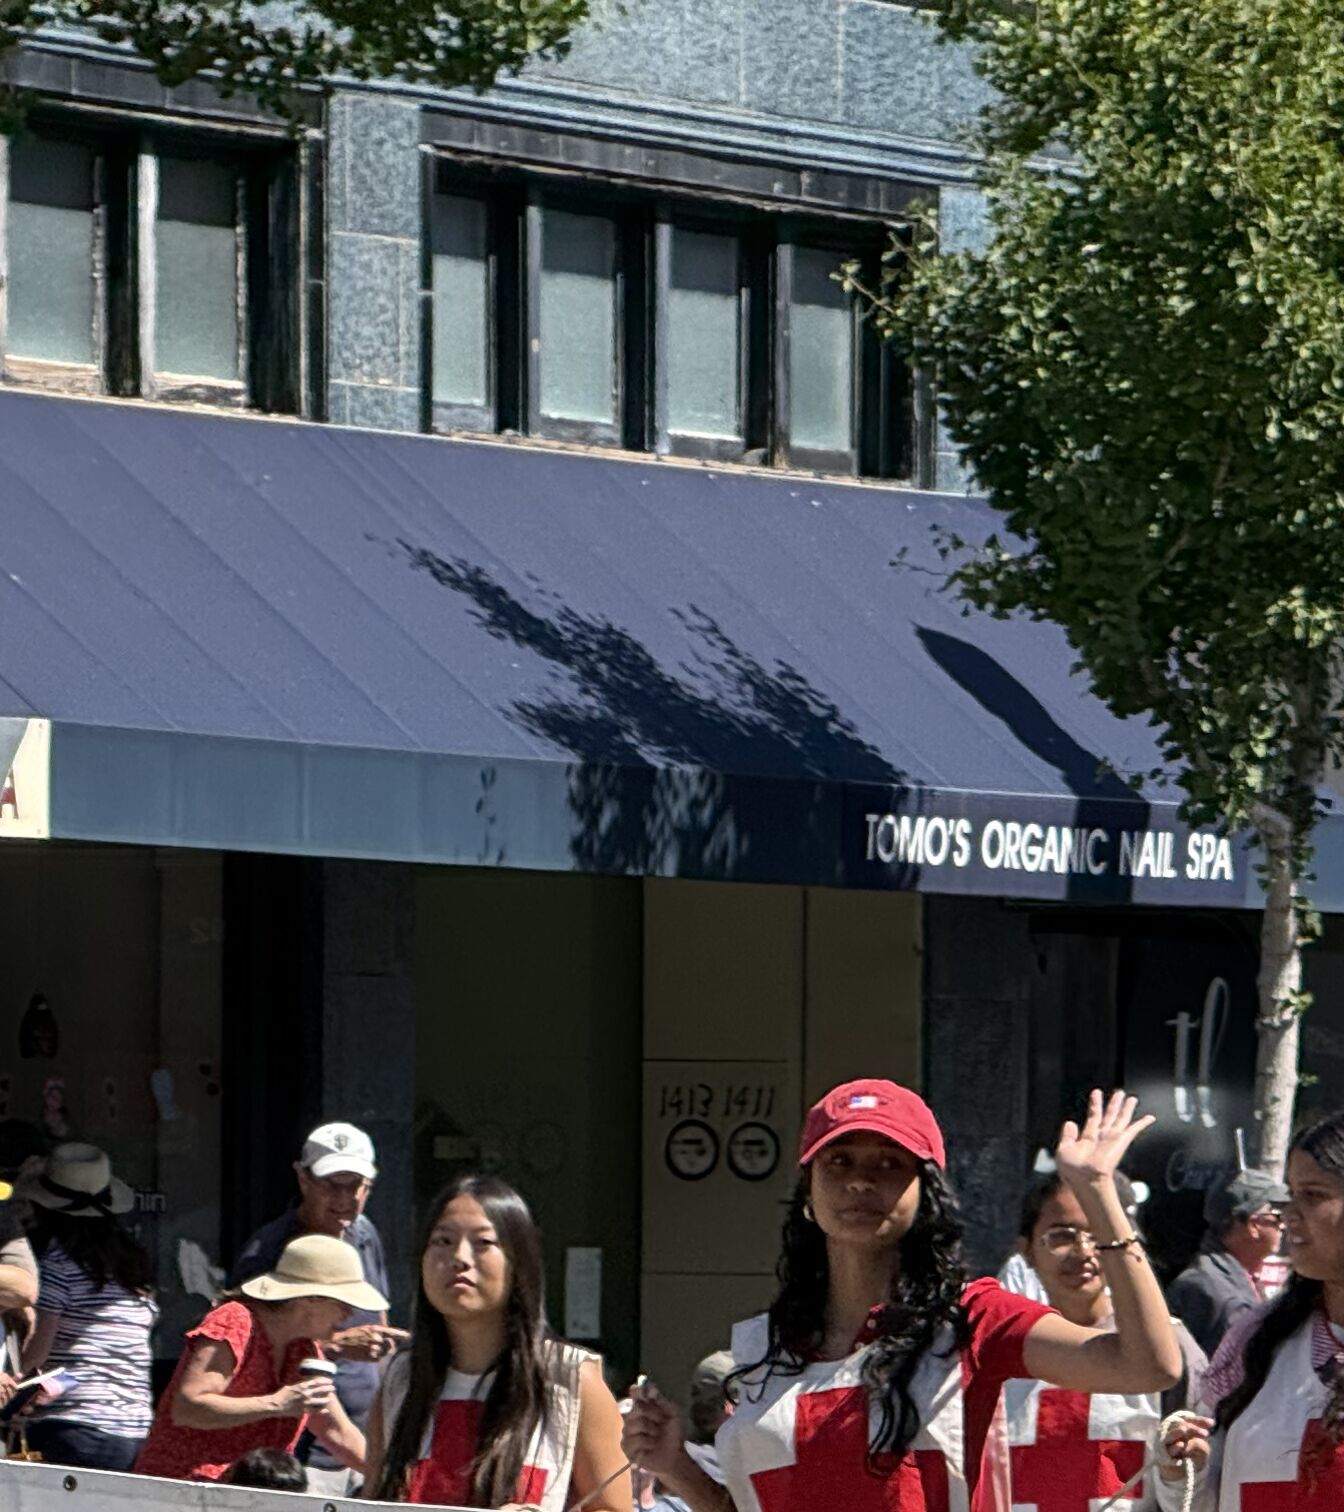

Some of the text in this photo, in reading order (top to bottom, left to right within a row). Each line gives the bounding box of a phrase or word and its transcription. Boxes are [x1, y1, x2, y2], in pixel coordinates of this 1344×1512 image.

[865, 814, 1234, 882] TOMO'S ORGANIC NAIL SPA
[659, 1083, 714, 1117] 1413
[724, 1085, 776, 1118] 1411
